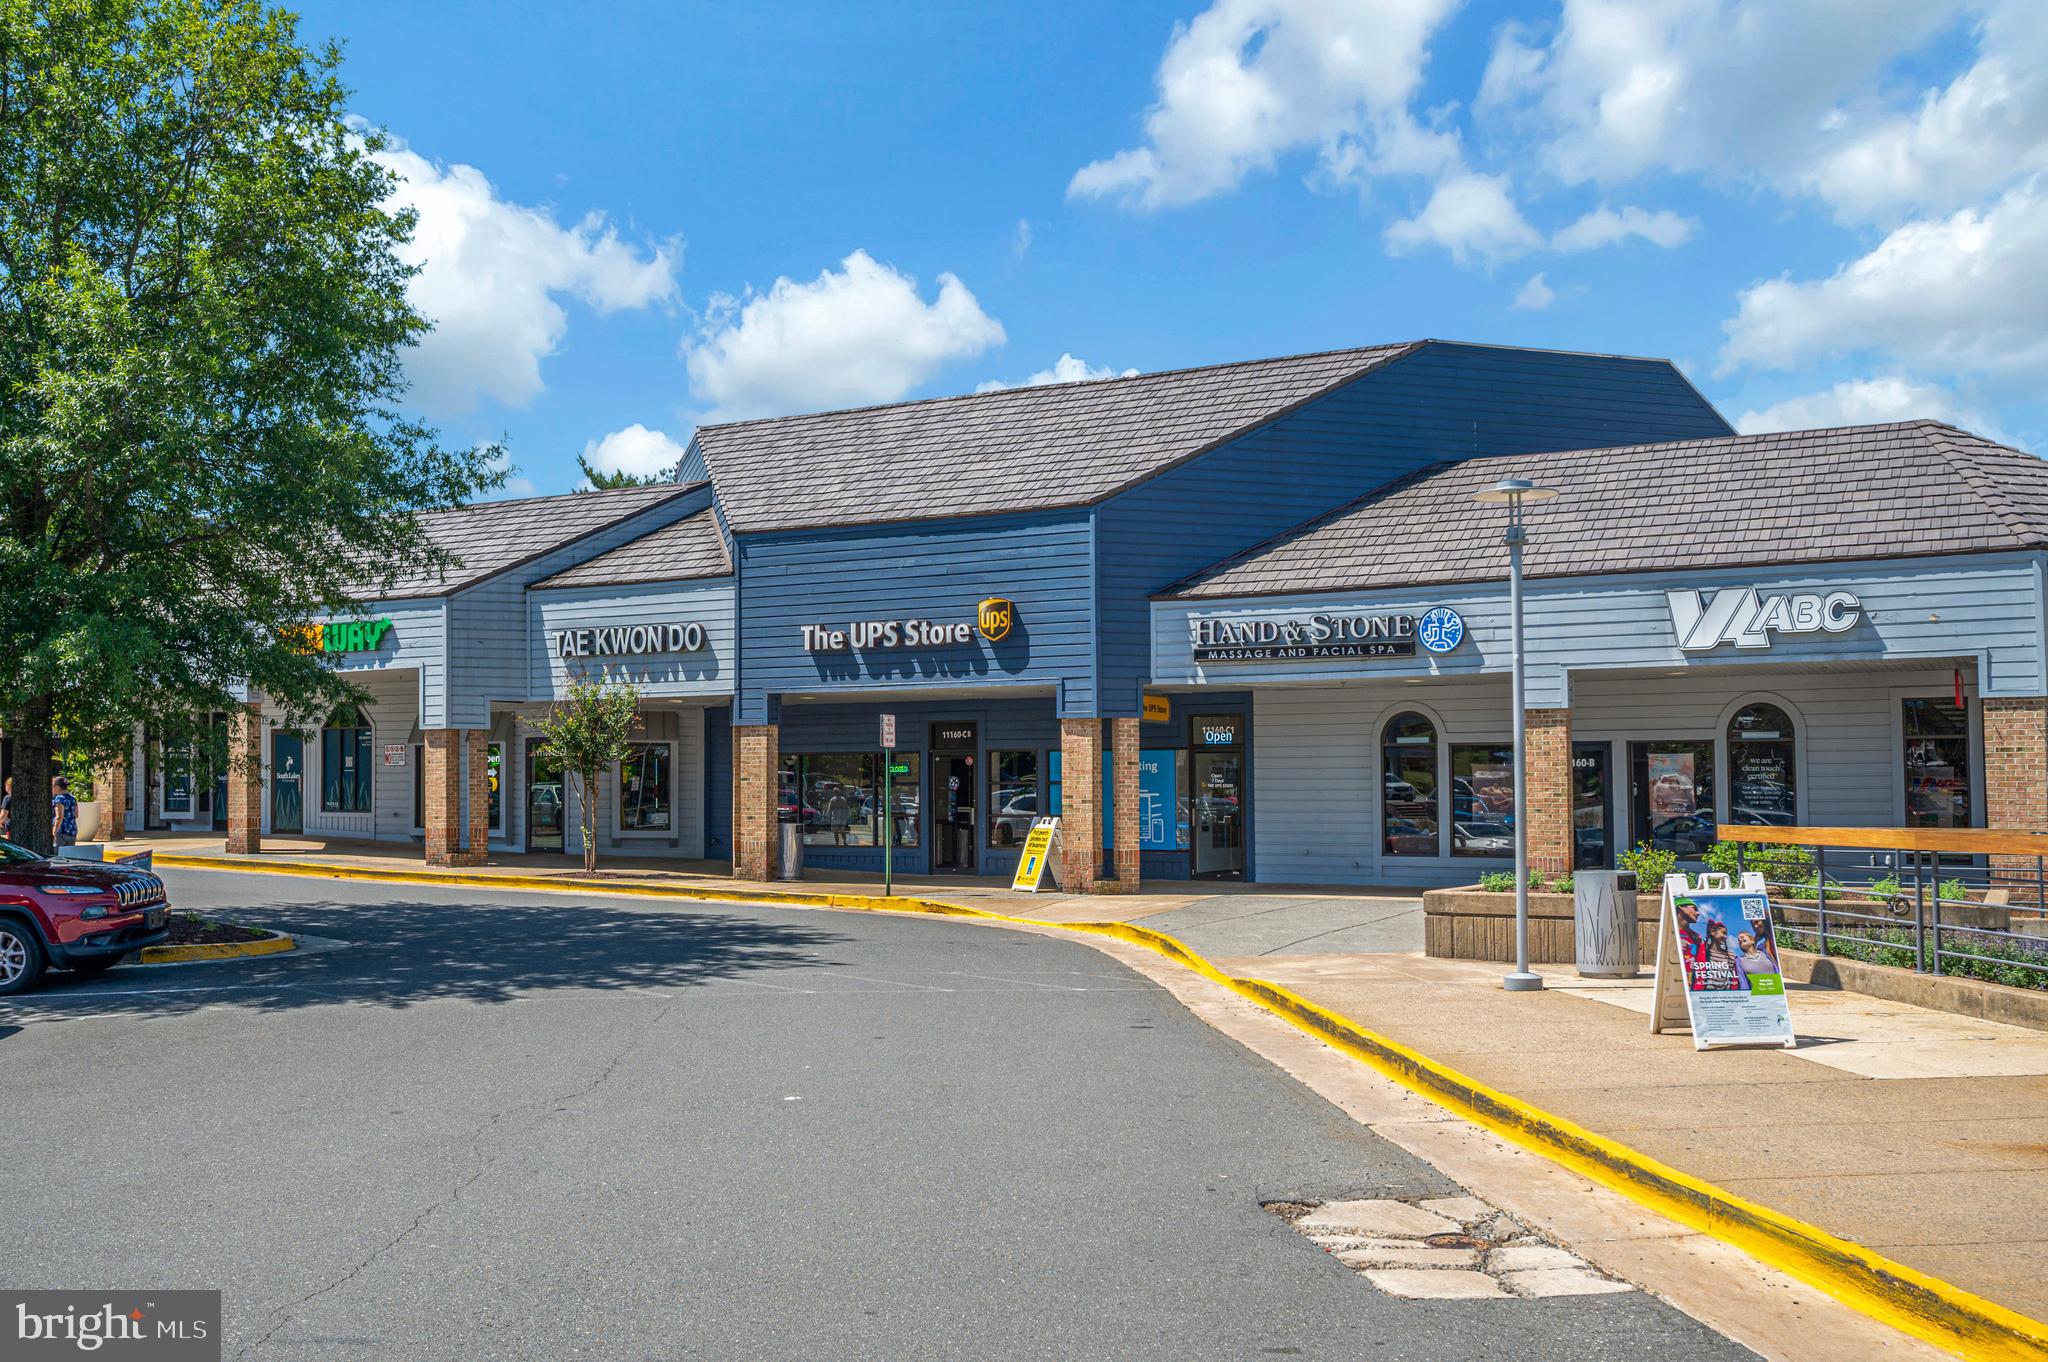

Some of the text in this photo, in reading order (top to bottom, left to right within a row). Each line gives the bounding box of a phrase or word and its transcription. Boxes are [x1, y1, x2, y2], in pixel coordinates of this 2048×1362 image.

[1743, 591, 1861, 634] ABC
[980, 610, 1009, 635] ups
[1195, 614, 1414, 645] HAND & STONE
[278, 617, 393, 656] WAY
[551, 622, 702, 657] TAE KWON DO
[800, 619, 970, 651] The UPS Store
[1207, 645, 1396, 659] MASSAGE AND FACIAL SPA
[1149, 704, 1158, 712] UPS
[1206, 731, 1232, 744] Open
[1572, 758, 1595, 767] 160-B
[1694, 961, 1729, 970] SPRING
[1695, 970, 1739, 978] FESTIVAL
